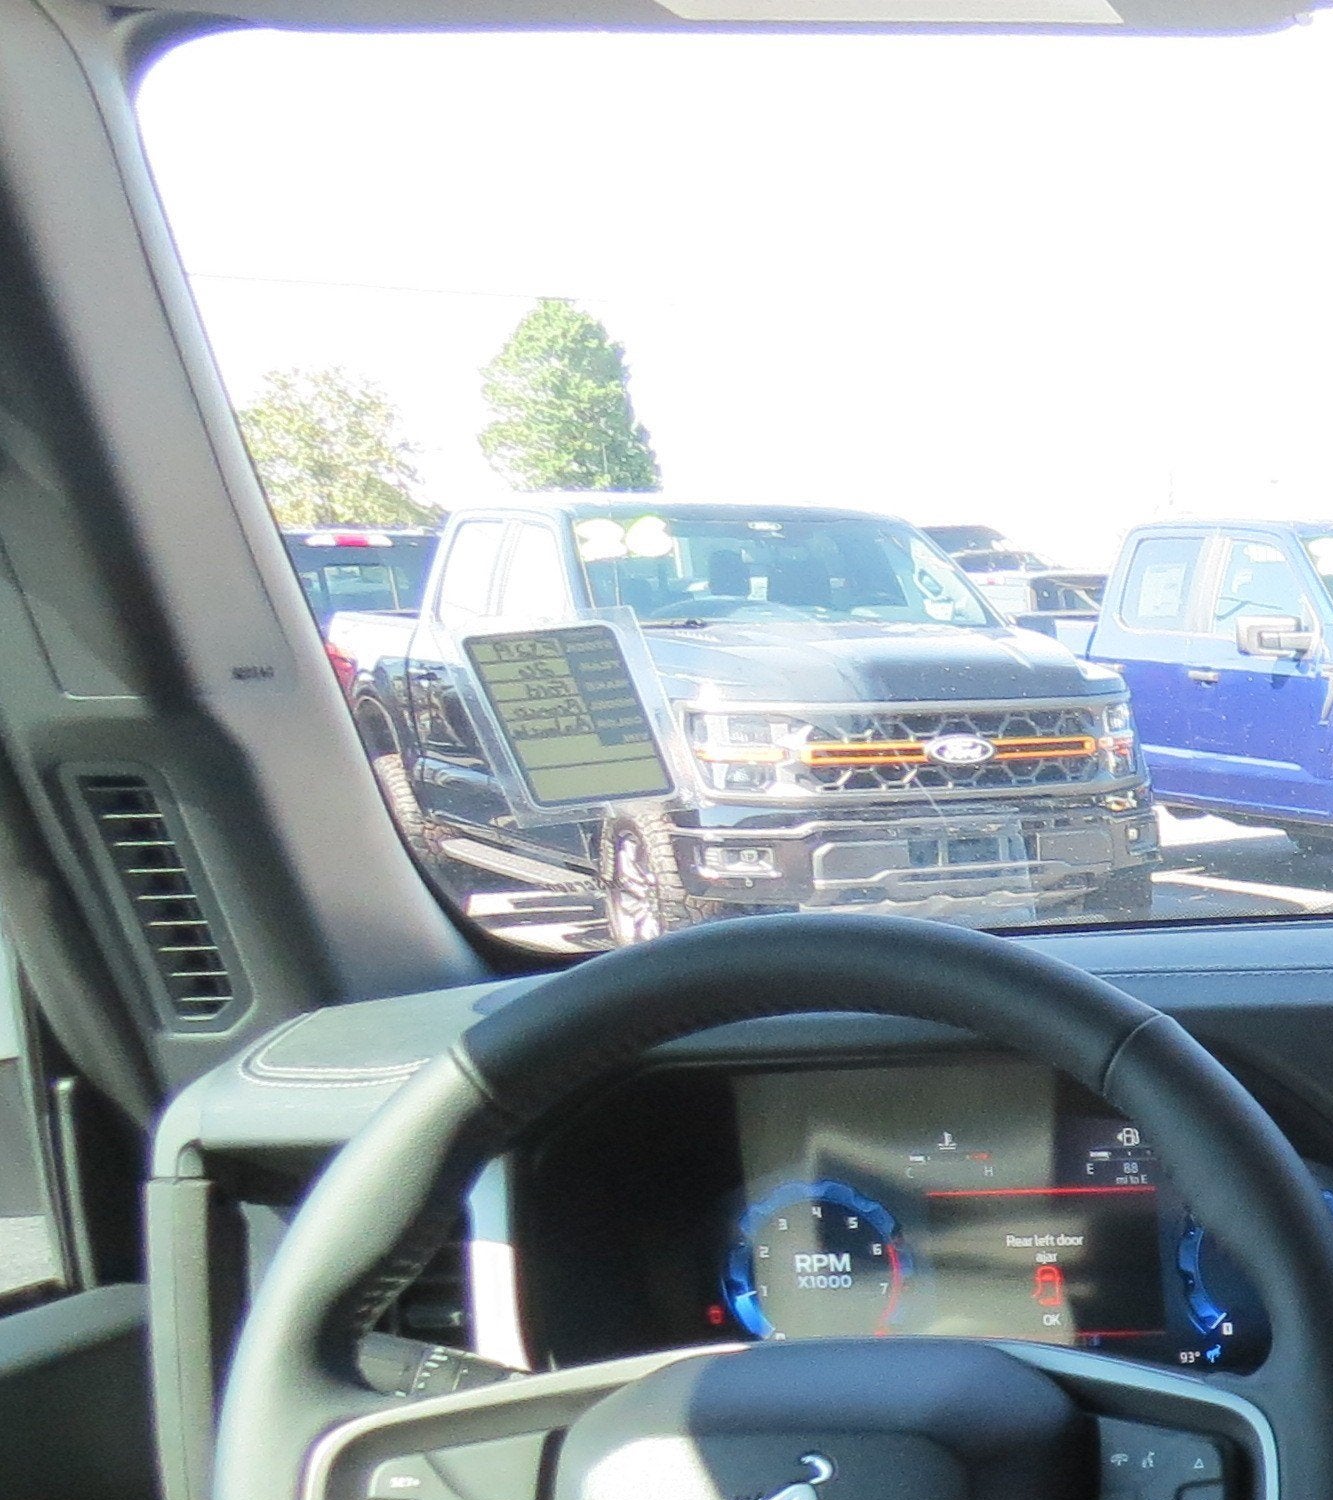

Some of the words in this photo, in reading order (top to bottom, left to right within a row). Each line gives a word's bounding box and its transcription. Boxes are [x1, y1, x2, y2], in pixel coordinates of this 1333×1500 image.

[1086, 1163, 1095, 1175] E
[812, 1206, 822, 1218] 4
[848, 1217, 858, 1229] 5
[1005, 1234, 1034, 1248] Rear
[1034, 1233, 1055, 1247] left
[1056, 1233, 1085, 1247] door
[760, 1246, 770, 1258] 2
[872, 1243, 882, 1256] 6
[795, 1252, 851, 1273] RPM
[1035, 1250, 1059, 1265] ajar
[798, 1275, 852, 1290] X1000
[1042, 1313, 1062, 1327] OK
